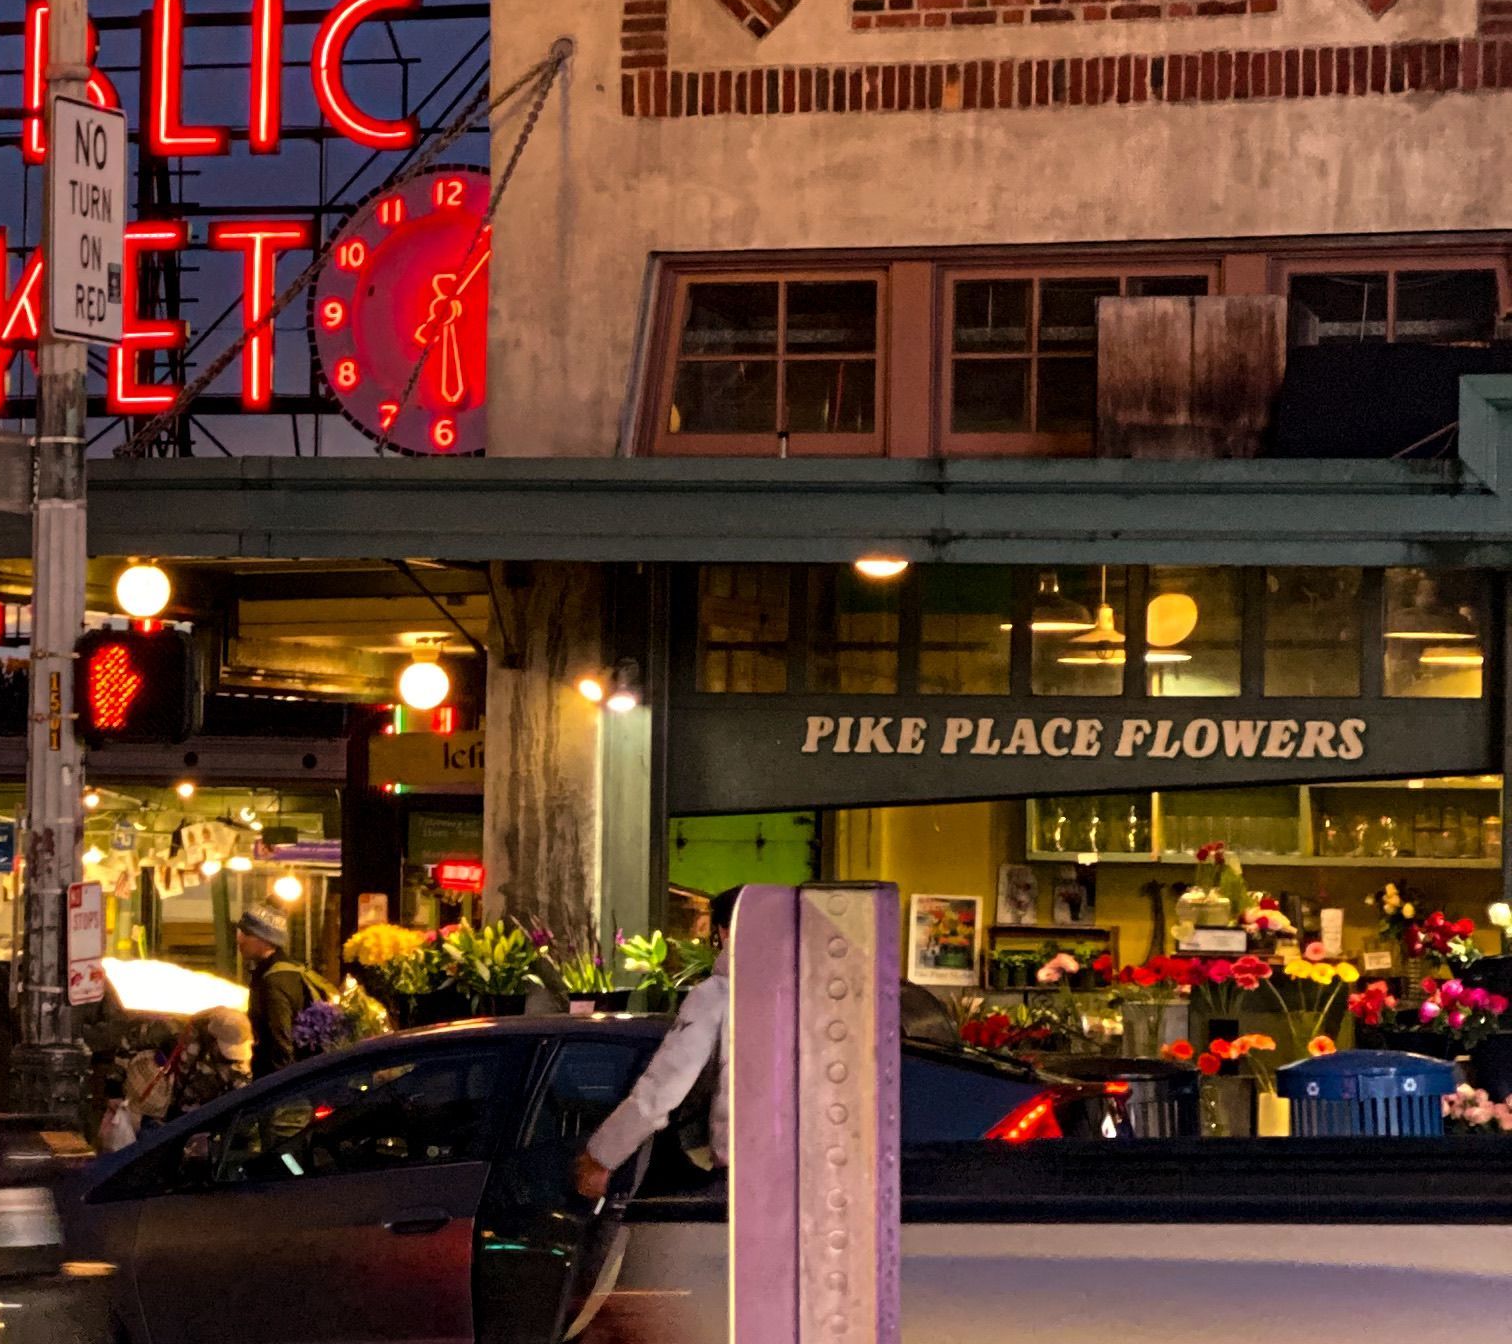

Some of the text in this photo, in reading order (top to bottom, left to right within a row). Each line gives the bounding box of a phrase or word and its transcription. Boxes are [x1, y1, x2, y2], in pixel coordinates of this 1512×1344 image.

[75, 119, 107, 170] NO
[69, 179, 112, 224] TURN
[435, 179, 463, 207] 12
[380, 197, 403, 225] 11
[80, 235, 102, 271] ON
[339, 241, 366, 268] 10
[75, 284, 106, 324] RED
[322, 301, 344, 327] 9
[336, 361, 357, 387] 8
[379, 403, 399, 429] 7
[433, 419, 455, 447] 6
[801, 715, 1368, 760] PIKE PLACE FLOWERS
